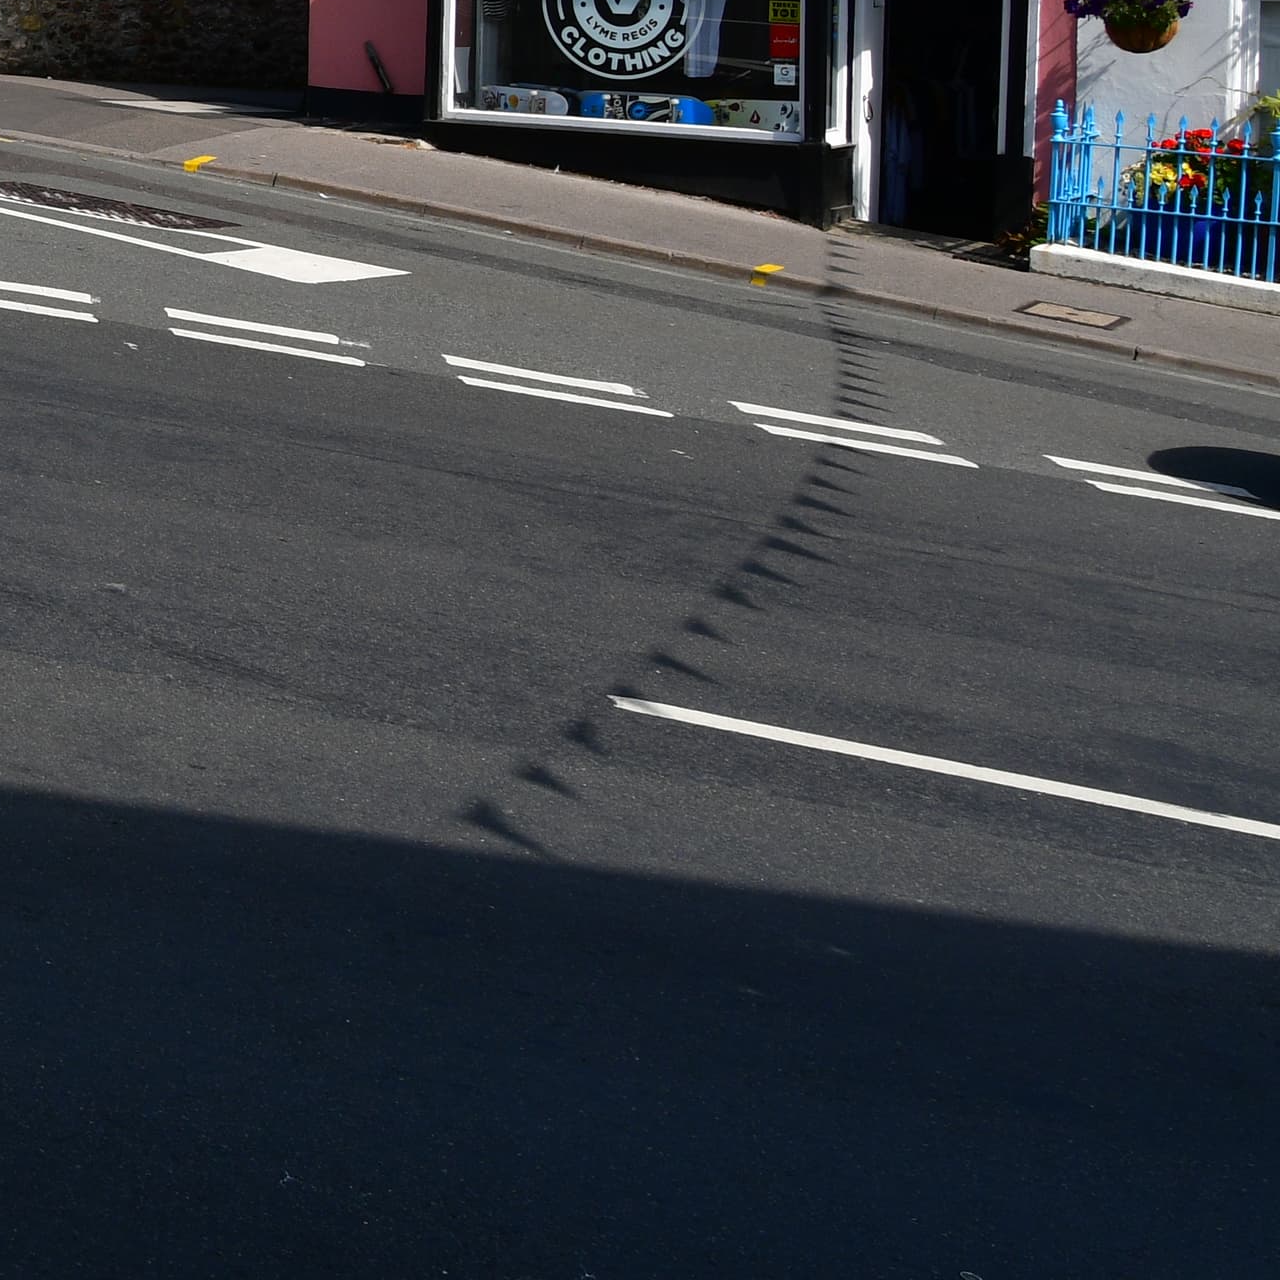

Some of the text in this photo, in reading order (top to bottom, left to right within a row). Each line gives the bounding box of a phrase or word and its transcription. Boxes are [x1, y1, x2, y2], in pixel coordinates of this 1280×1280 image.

[772, 8, 798, 18] YOU
[586, 15, 659, 42] LYME REGIS
[560, 25, 685, 71] CLOTHING
